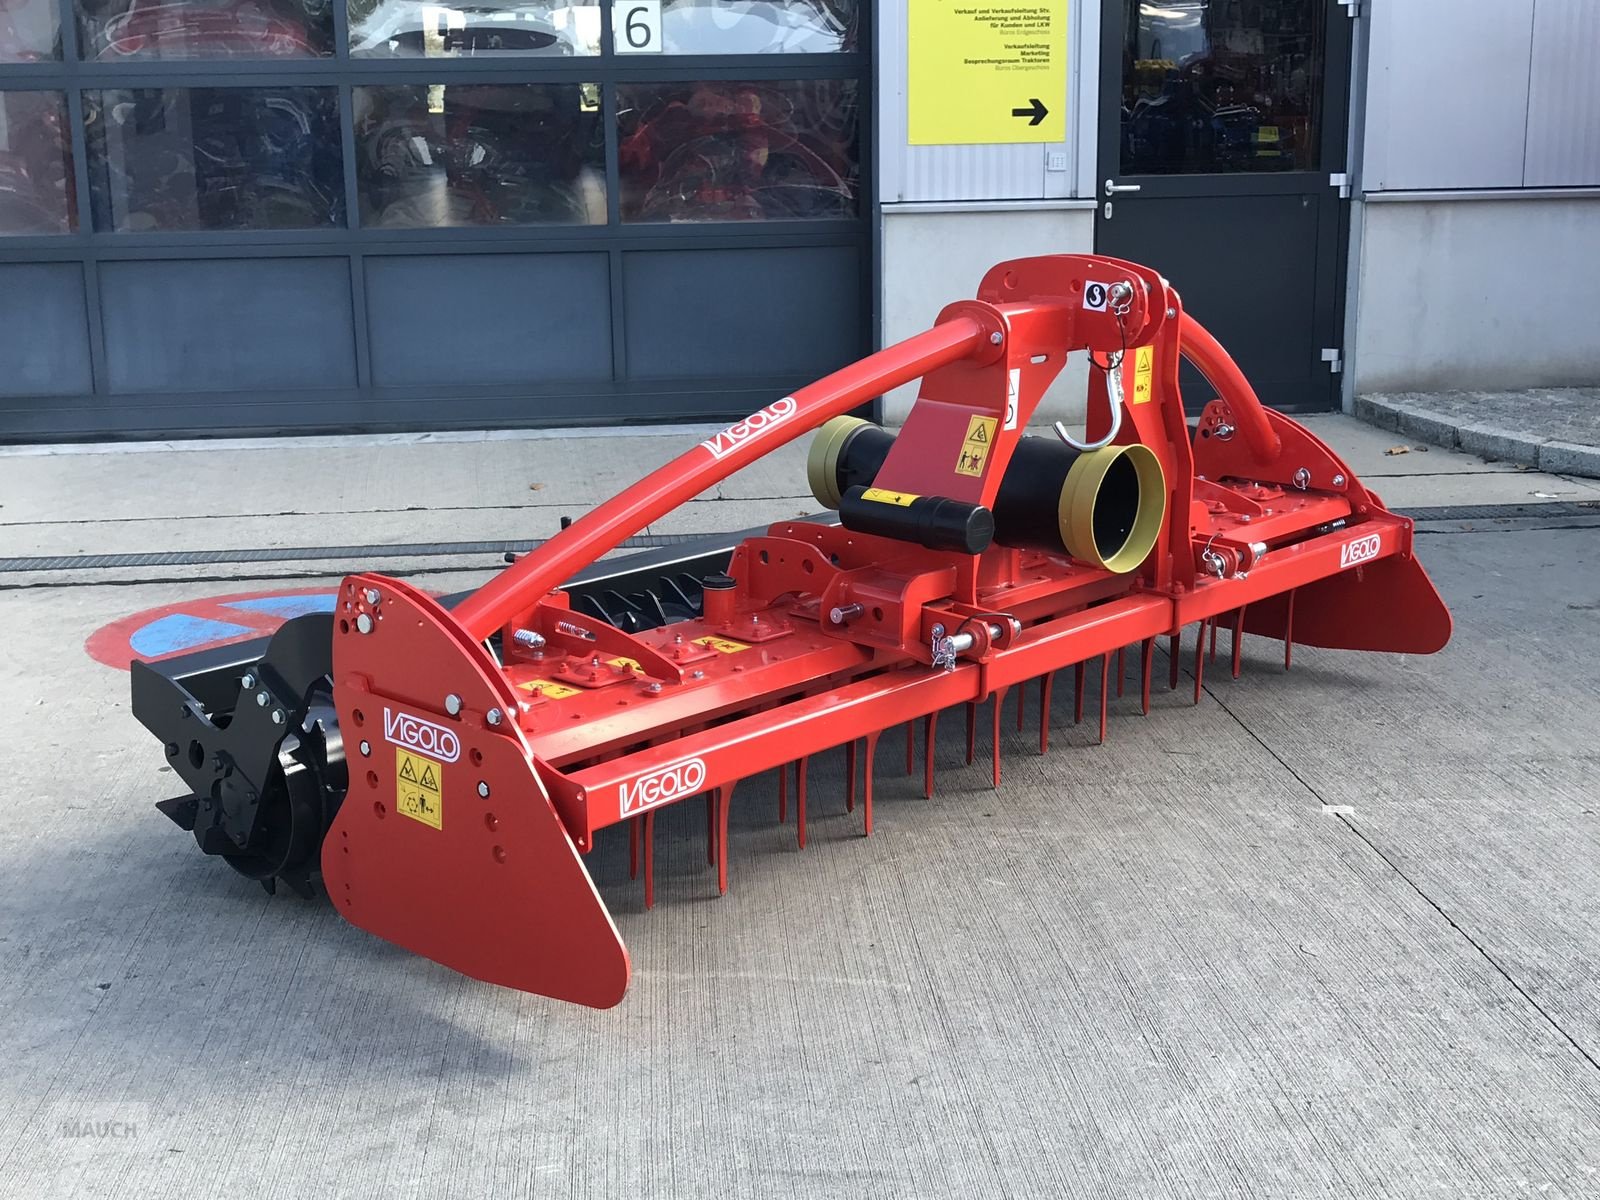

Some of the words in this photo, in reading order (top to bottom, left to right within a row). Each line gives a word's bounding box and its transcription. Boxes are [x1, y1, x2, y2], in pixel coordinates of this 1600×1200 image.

[625, 6, 652, 49] 6
[700, 397, 797, 460] VIGOLO
[1341, 534, 1381, 568] VIGOLO
[383, 706, 460, 762] VIGOLO
[619, 757, 706, 819] VIGOLO
